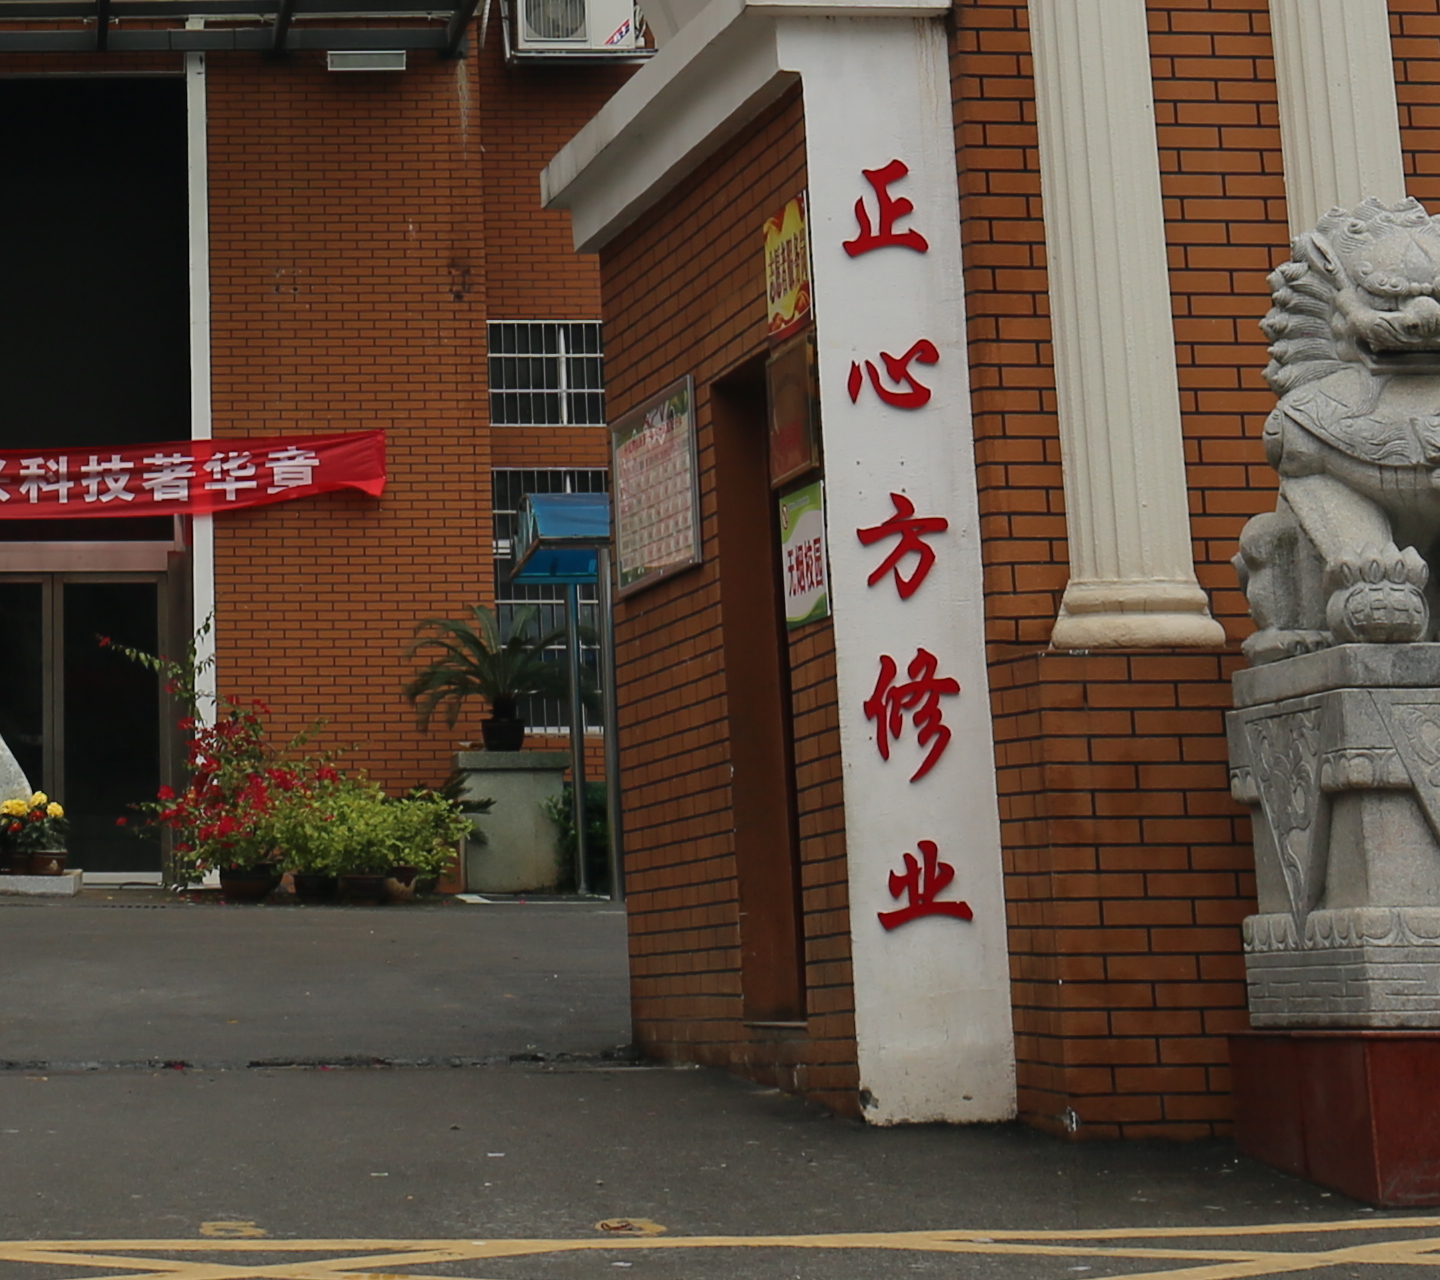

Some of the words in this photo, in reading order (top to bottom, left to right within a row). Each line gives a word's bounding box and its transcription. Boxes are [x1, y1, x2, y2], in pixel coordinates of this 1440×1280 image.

[843, 160, 973, 929] 正心方修业
